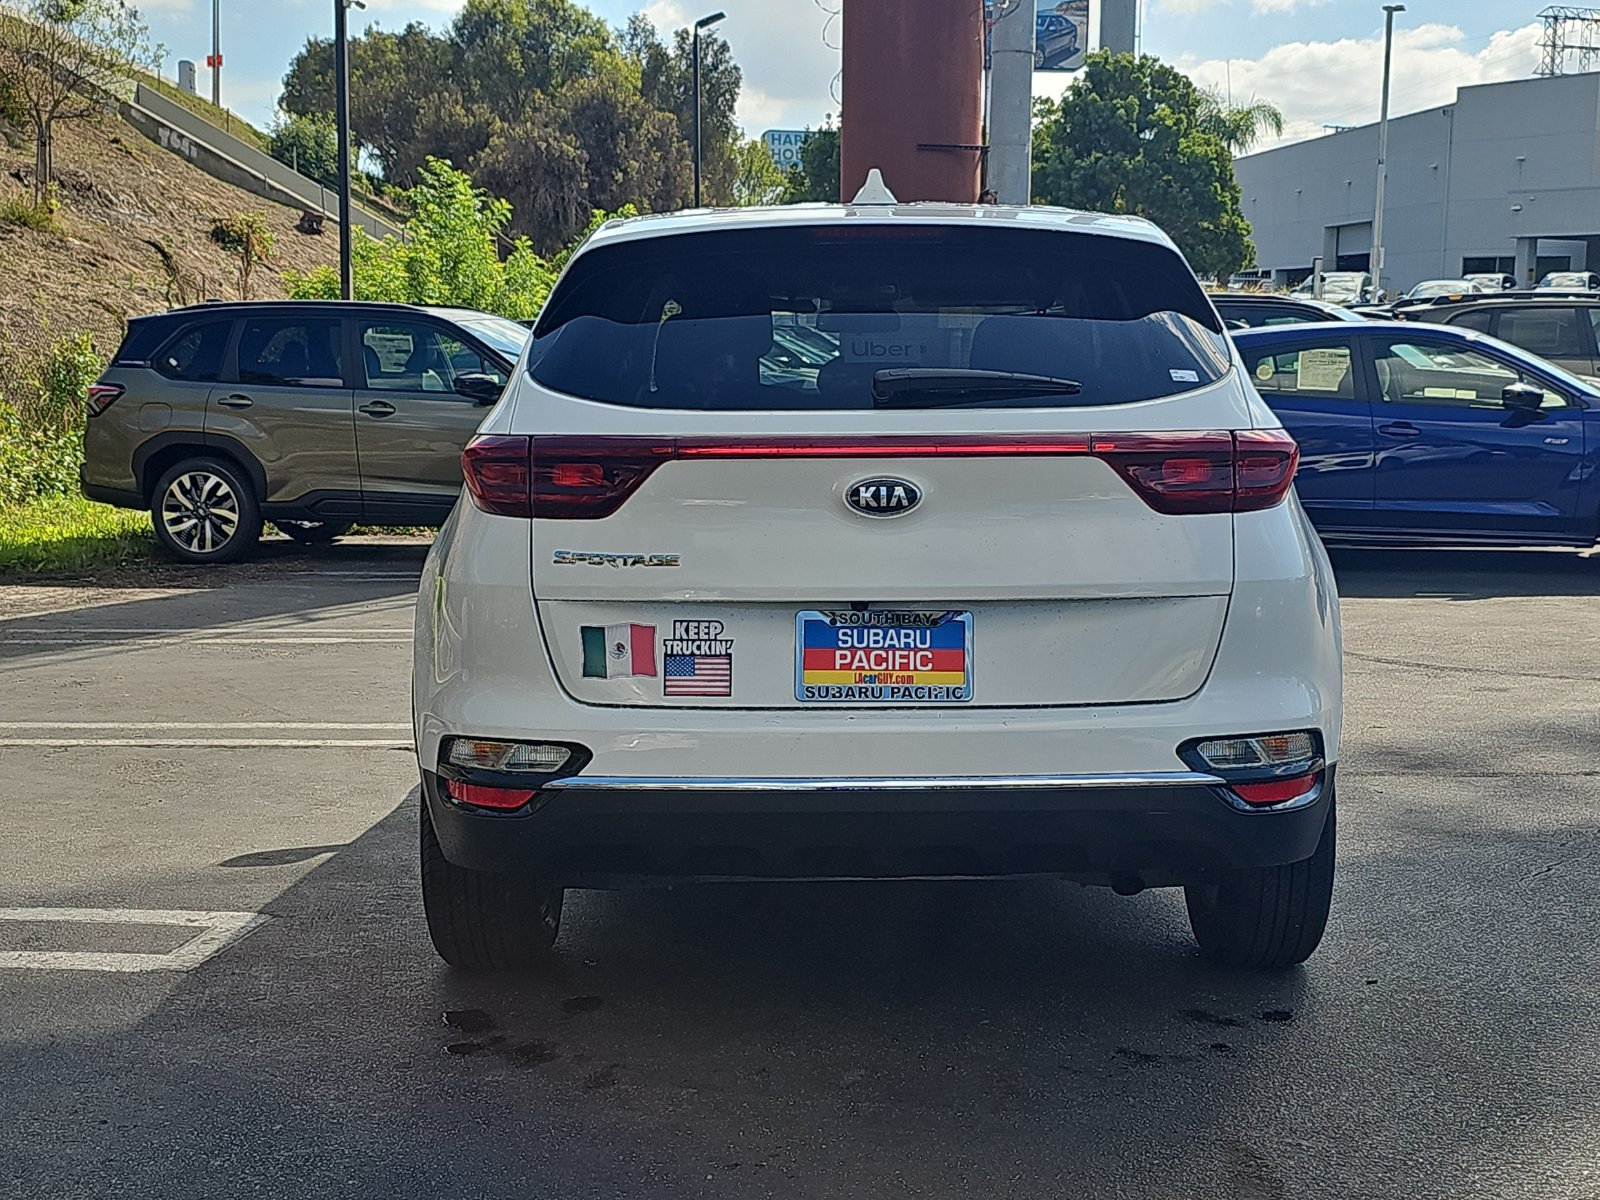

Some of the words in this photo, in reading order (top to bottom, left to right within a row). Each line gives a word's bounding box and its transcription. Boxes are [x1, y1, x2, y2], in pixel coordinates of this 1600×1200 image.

[851, 341, 912, 357] Uber
[859, 486, 909, 507] KIA
[553, 550, 681, 568] SPORTAGE
[838, 612, 897, 625] SOUTH
[901, 612, 934, 625] BAY
[674, 621, 723, 640] KEEP
[837, 628, 931, 649] SUBARU
[665, 640, 732, 655] TRUCKIN'
[834, 650, 933, 671] PACIFIC
[853, 672, 915, 685] LAcarGUY.com
[805, 686, 883, 699] SUBARU
[890, 686, 964, 699] PACIFIC
